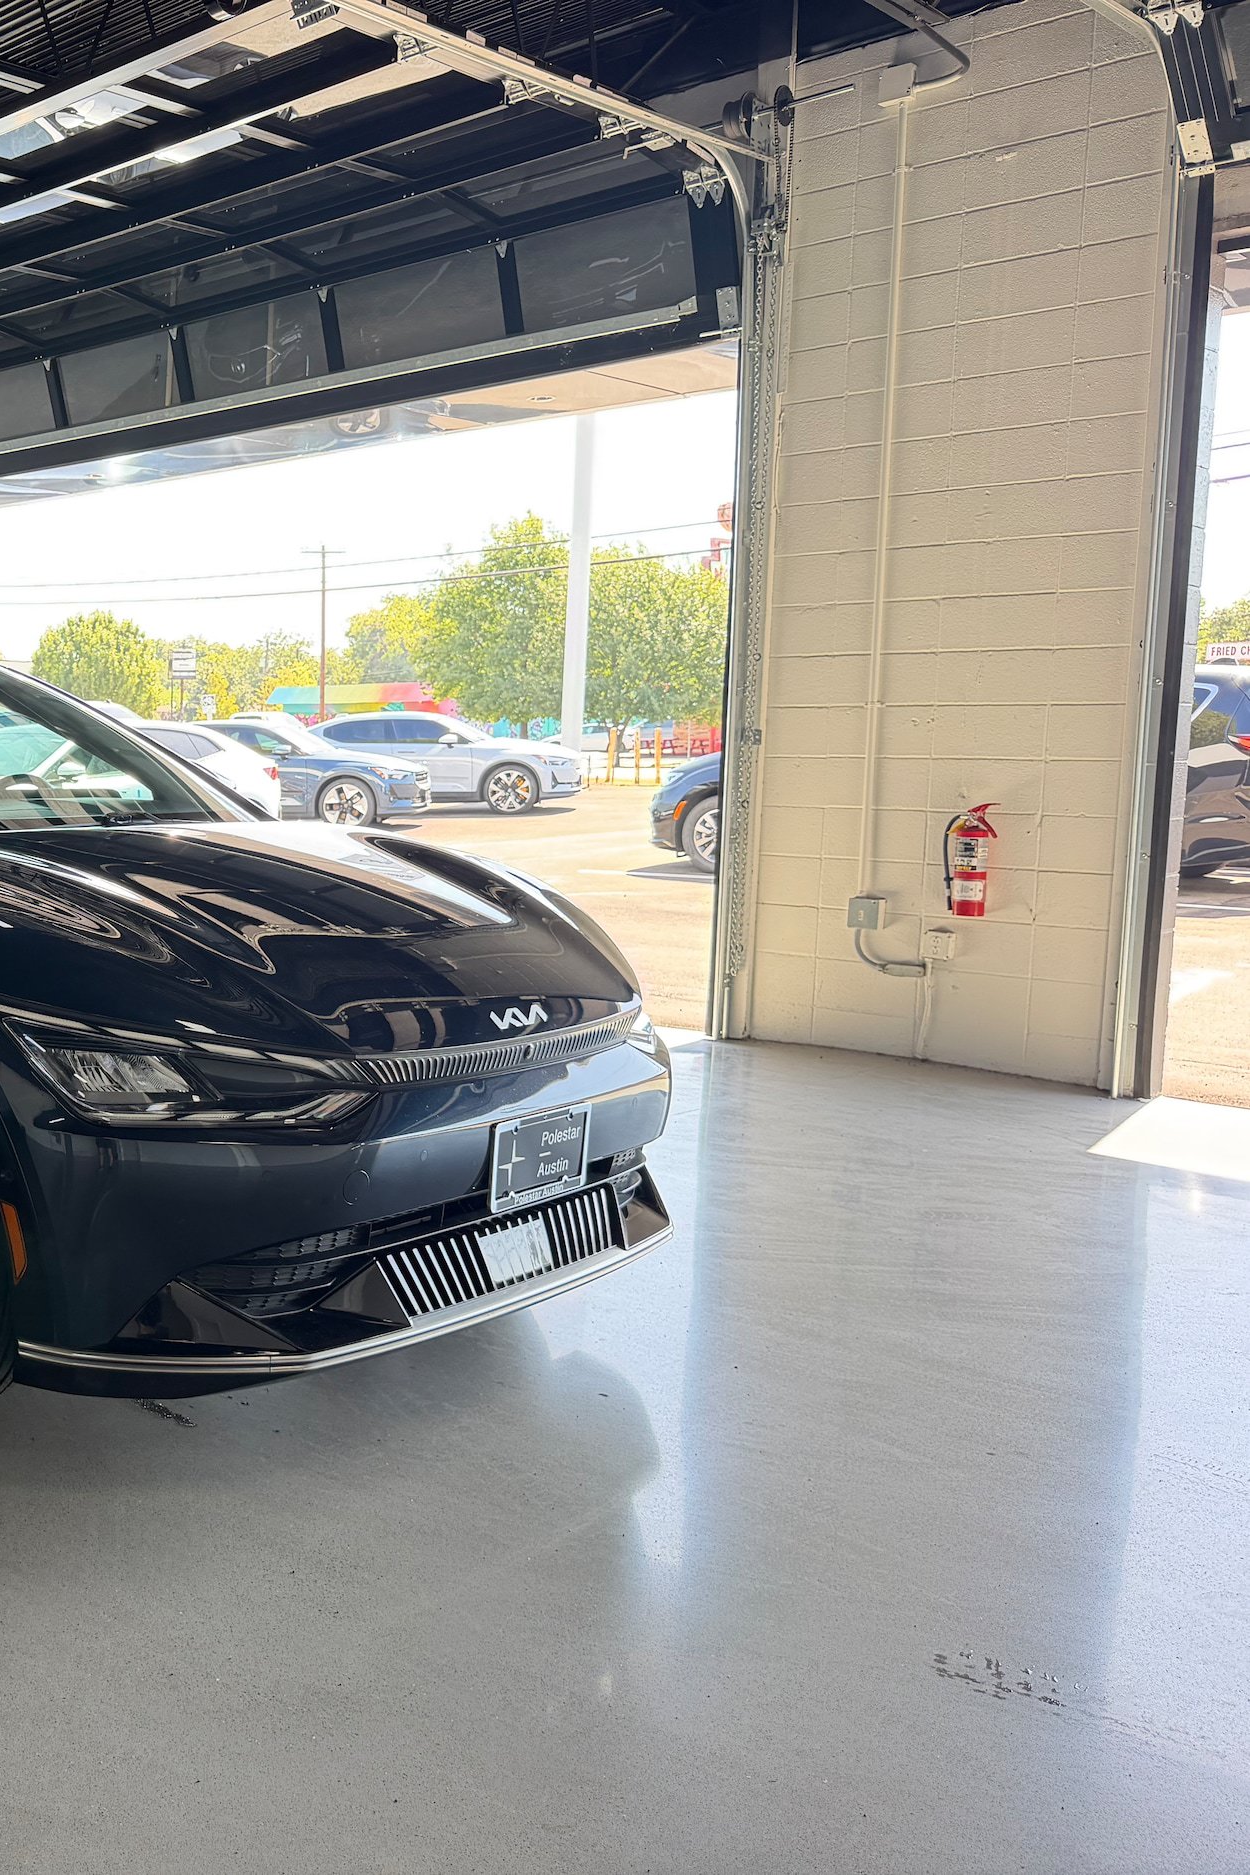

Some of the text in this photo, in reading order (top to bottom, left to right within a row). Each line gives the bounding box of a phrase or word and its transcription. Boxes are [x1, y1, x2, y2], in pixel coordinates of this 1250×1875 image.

[1211, 646, 1237, 656] FRIED
[541, 1126, 581, 1146] Polestar
[537, 1157, 569, 1178] Austin
[514, 1184, 564, 1205] Polestar Austin
